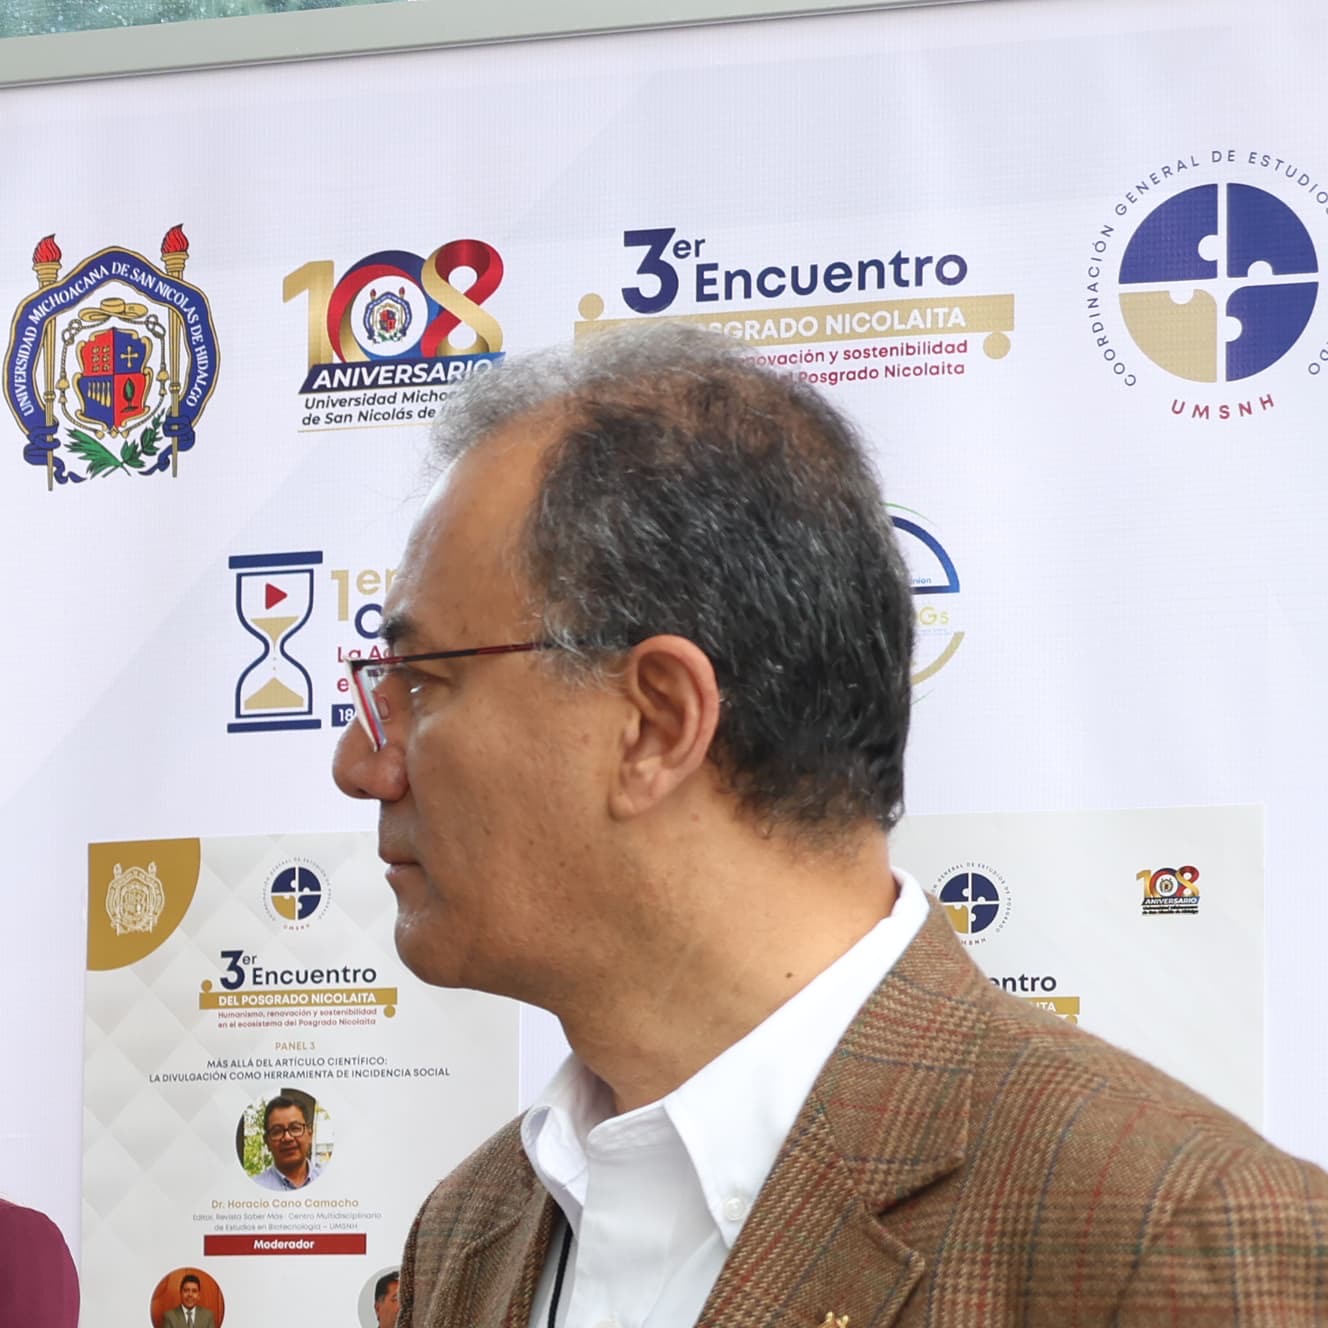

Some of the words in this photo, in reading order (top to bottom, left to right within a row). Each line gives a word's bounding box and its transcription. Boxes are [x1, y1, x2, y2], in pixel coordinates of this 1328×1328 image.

[111, 262, 129, 276] DE
[129, 268, 154, 288] SAN
[696, 250, 967, 302] Encuentro
[1087, 224, 1136, 386] COORDINACIÓN
[1115, 156, 1200, 216] GENERAL
[1212, 150, 1236, 162] DE
[29, 266, 109, 325] MICHOACANA
[154, 281, 199, 325] NICOLAS
[710, 322, 818, 341] GRADO
[825, 307, 966, 334] NICOLAITA
[191, 325, 203, 344] DE
[829, 351, 838, 364] y
[843, 340, 968, 360] sostenibilidad
[14, 327, 37, 417] UNIVERSIDAD
[186, 346, 209, 407] HIDALGO
[799, 366, 879, 386] Posgrado
[885, 361, 965, 379] Nicolaita
[305, 393, 397, 409] Universidad
[1171, 394, 1274, 420] UMSNH
[302, 414, 320, 426] de
[325, 413, 352, 424] San
[358, 408, 413, 423] Nicolás
[418, 406, 436, 419] de
[251, 965, 376, 985] Encuentro
[218, 994, 239, 1006] DEL
[242, 993, 308, 1006] POSGRADO
[311, 992, 376, 1004] NICOLAITA
[275, 1041, 305, 1051] PANEL
[310, 1041, 315, 1050] 3
[207, 1057, 228, 1069] MÁS
[230, 1055, 253, 1068] ALLÁ
[256, 1058, 273, 1067] DEL
[275, 1055, 324, 1067] ARTÍCULO
[326, 1055, 387, 1067] CIENTÍFICO:
[149, 1074, 160, 1082] LA
[162, 1070, 227, 1082] DIVULGACIÓN
[229, 1070, 262, 1080] COMO
[263, 1069, 334, 1081] HERRAMIENTA
[336, 1069, 349, 1079] DE
[351, 1067, 411, 1078] INCIDENCIA
[413, 1067, 449, 1077] SOCIAL
[227, 1199, 269, 1208] Horacio
[272, 1199, 301, 1209] Cano
[304, 1198, 359, 1208] Camacho
[253, 1238, 314, 1250] Moderador
